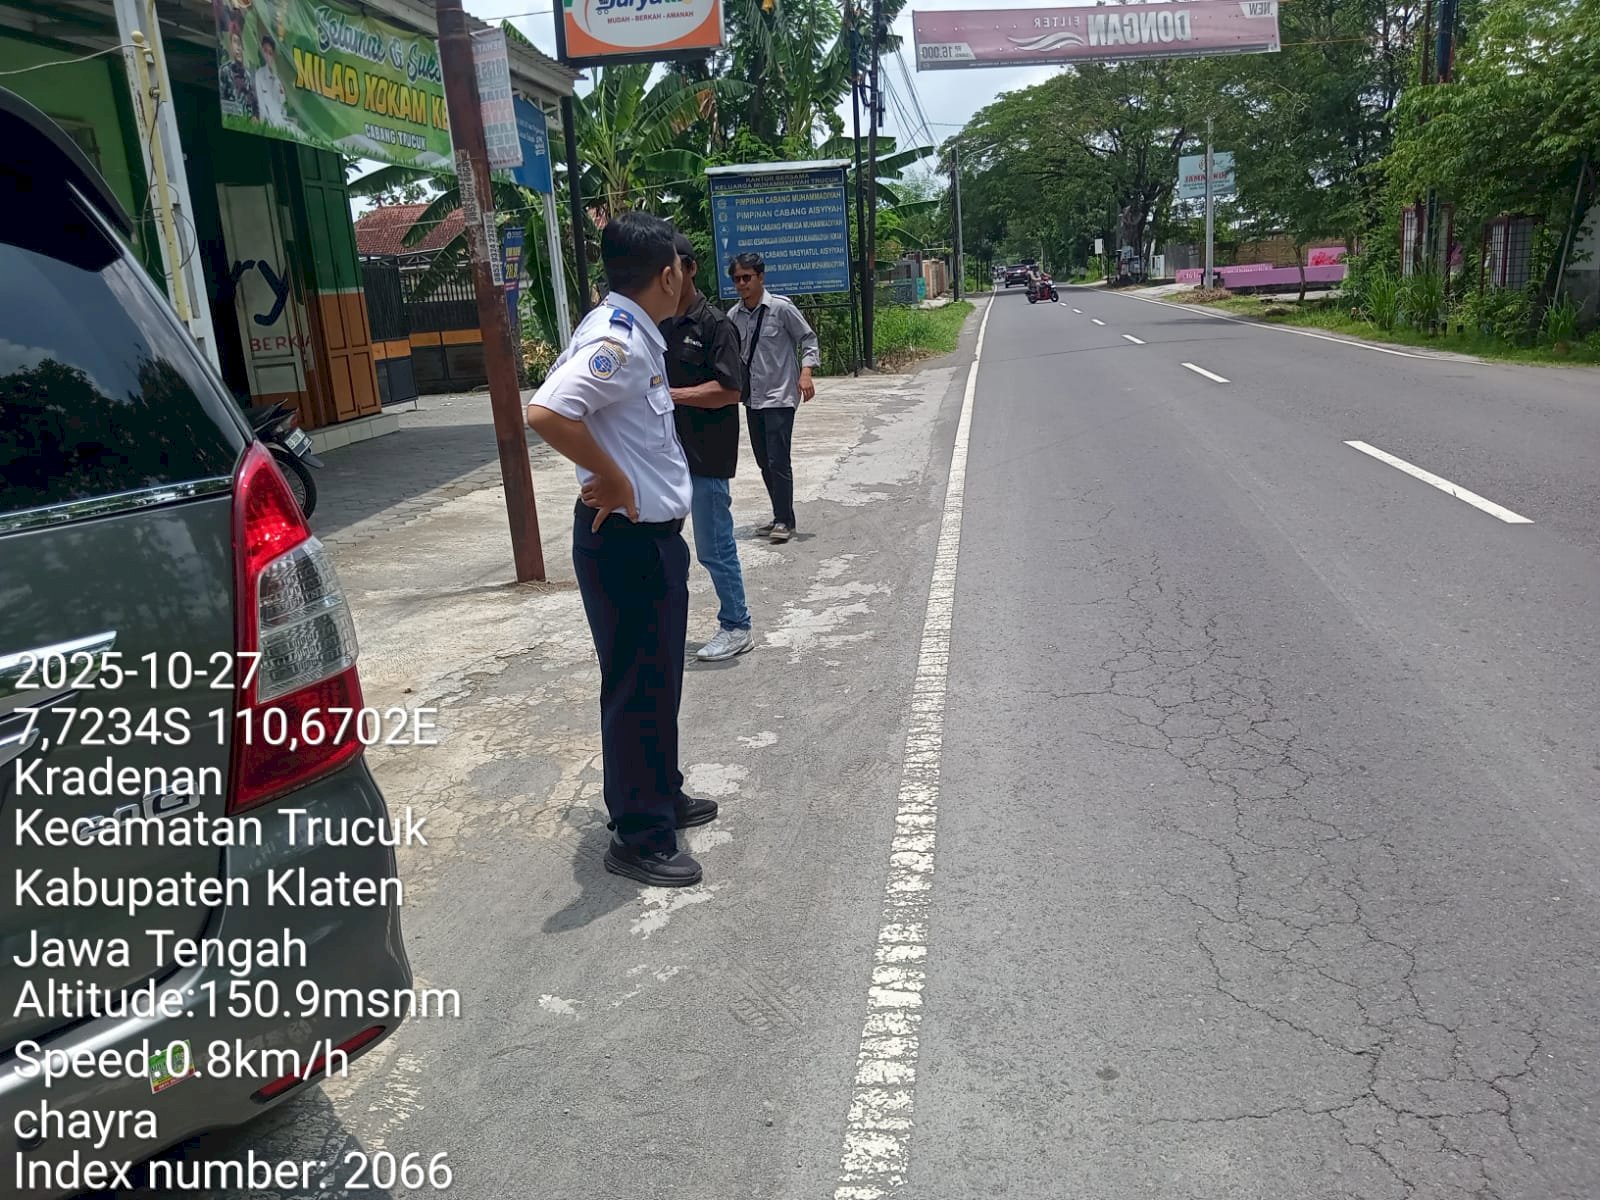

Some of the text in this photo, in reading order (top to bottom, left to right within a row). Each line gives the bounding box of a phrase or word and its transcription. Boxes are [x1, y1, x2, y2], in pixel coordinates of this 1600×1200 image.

[607, 15, 630, 24] MUDAH
[635, 13, 661, 21] BERKAH
[292, 48, 360, 107] MILAD
[364, 122, 427, 151] CABANG TRUCUK
[735, 191, 841, 206] PIMPINAN CABANG MUHAMMADIYAH
[736, 204, 842, 220] PIMPINAN CABANG AISYIYAH
[766, 249, 789, 258] CABANG
